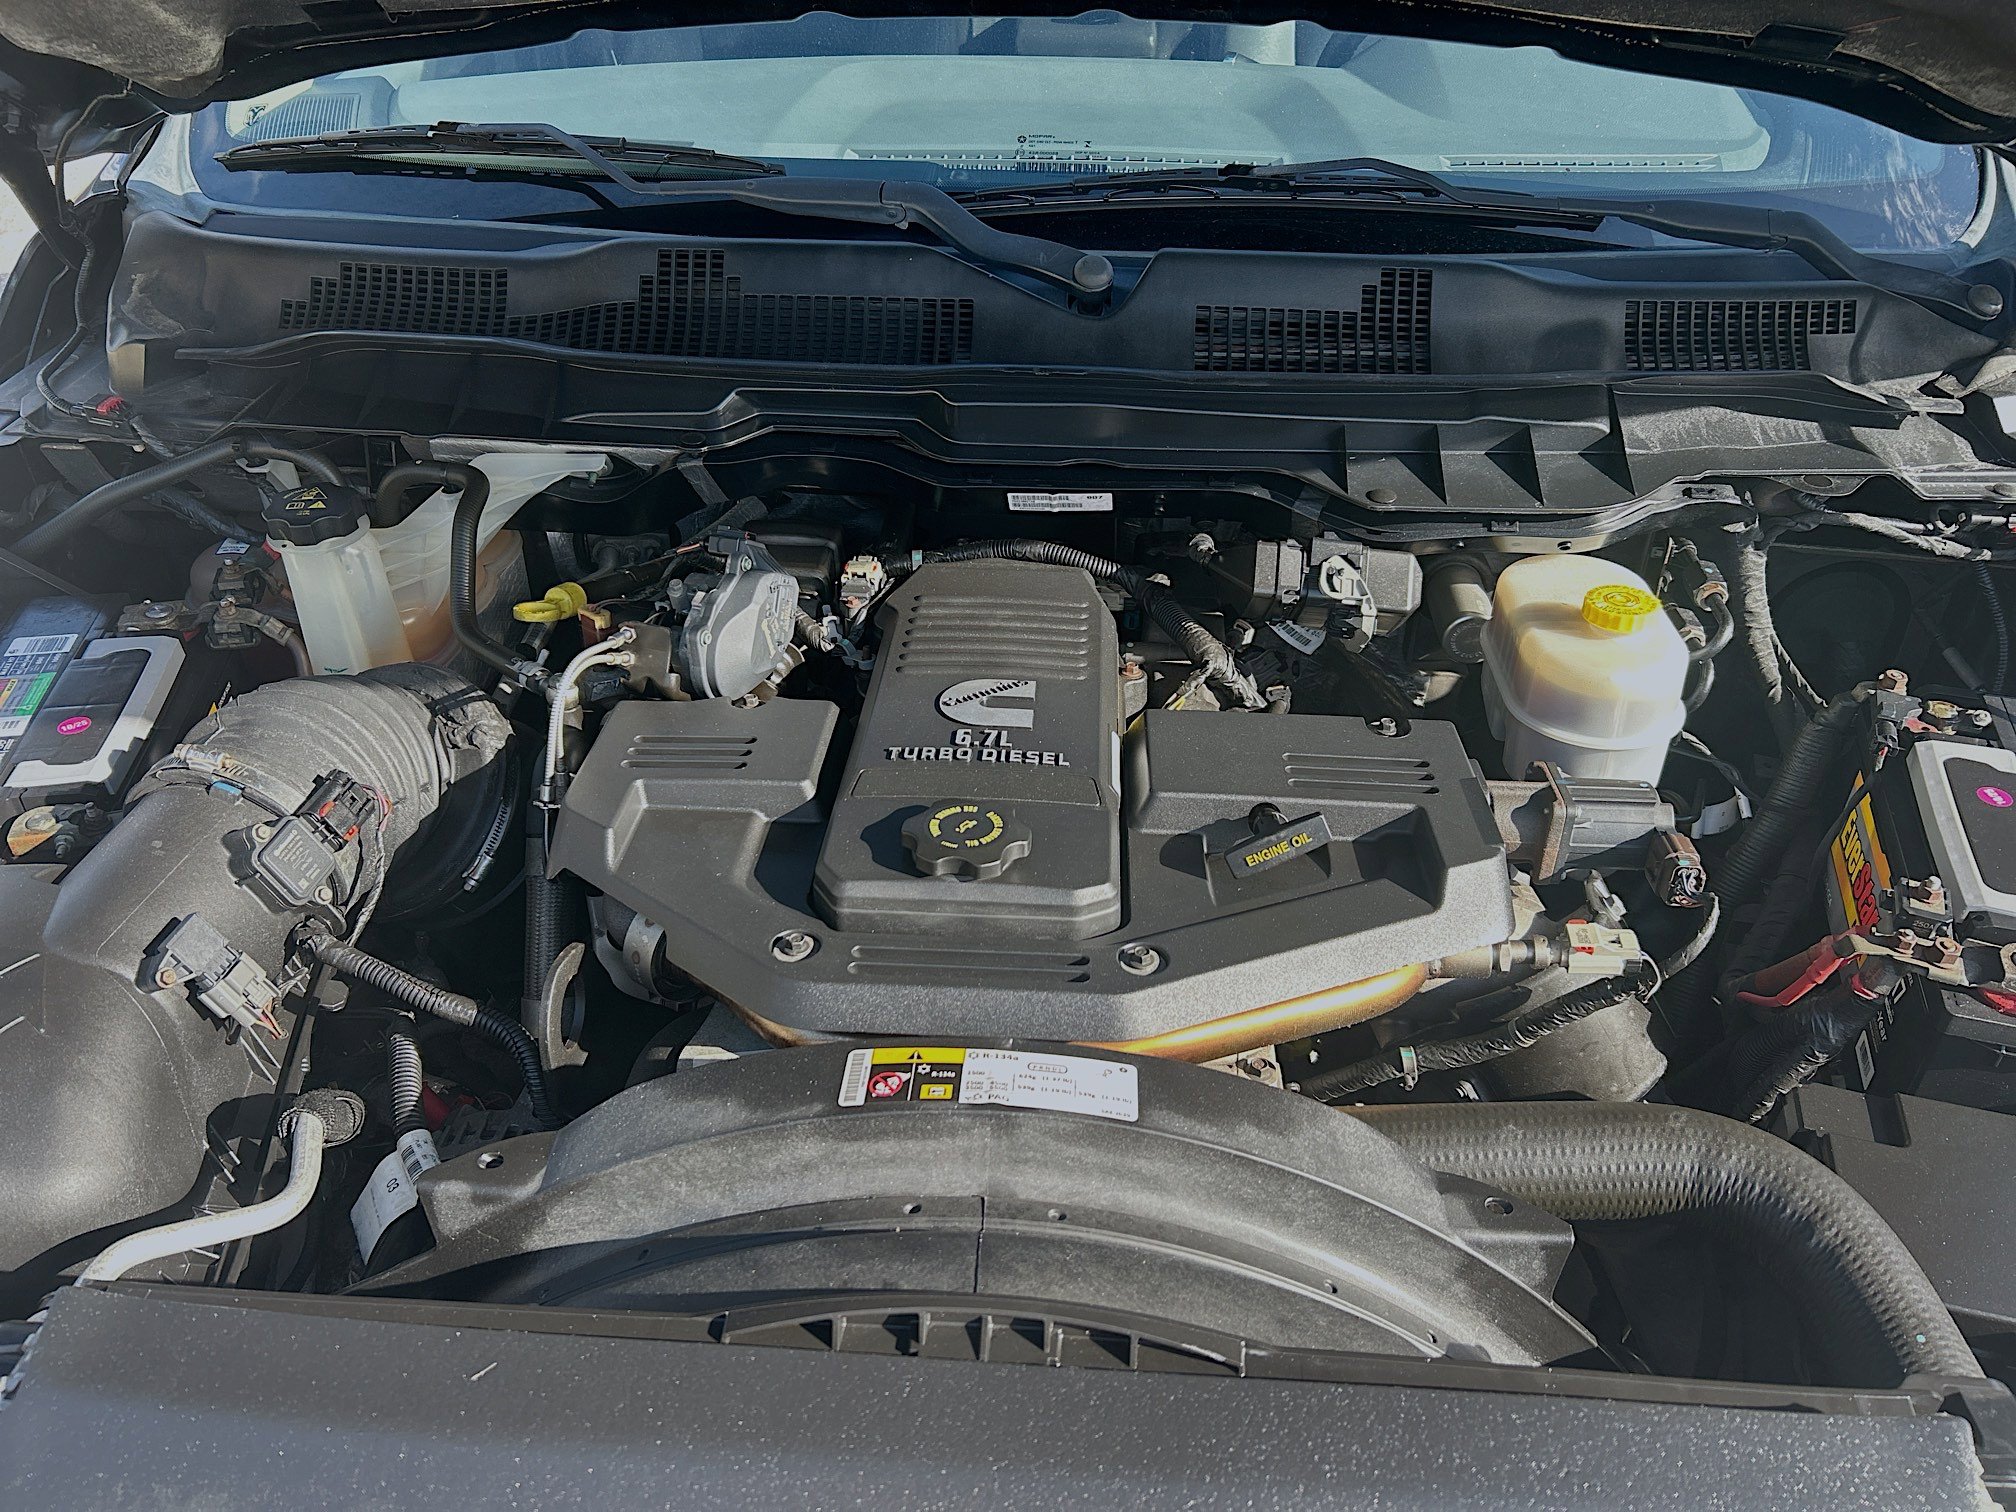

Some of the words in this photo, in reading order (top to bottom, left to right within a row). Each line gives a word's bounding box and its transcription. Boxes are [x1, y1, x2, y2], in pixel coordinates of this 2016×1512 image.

[941, 680, 1029, 707] Cummins
[60, 719, 88, 733] 10/25
[953, 729, 1013, 748] 6.7L
[886, 747, 974, 763] TURBO
[979, 748, 1071, 767] DIESEL
[1245, 840, 1291, 867] ENGINE
[1291, 832, 1313, 848] OIL
[1840, 808, 1881, 926] EverStar
[983, 1052, 1019, 1061] R-134a
